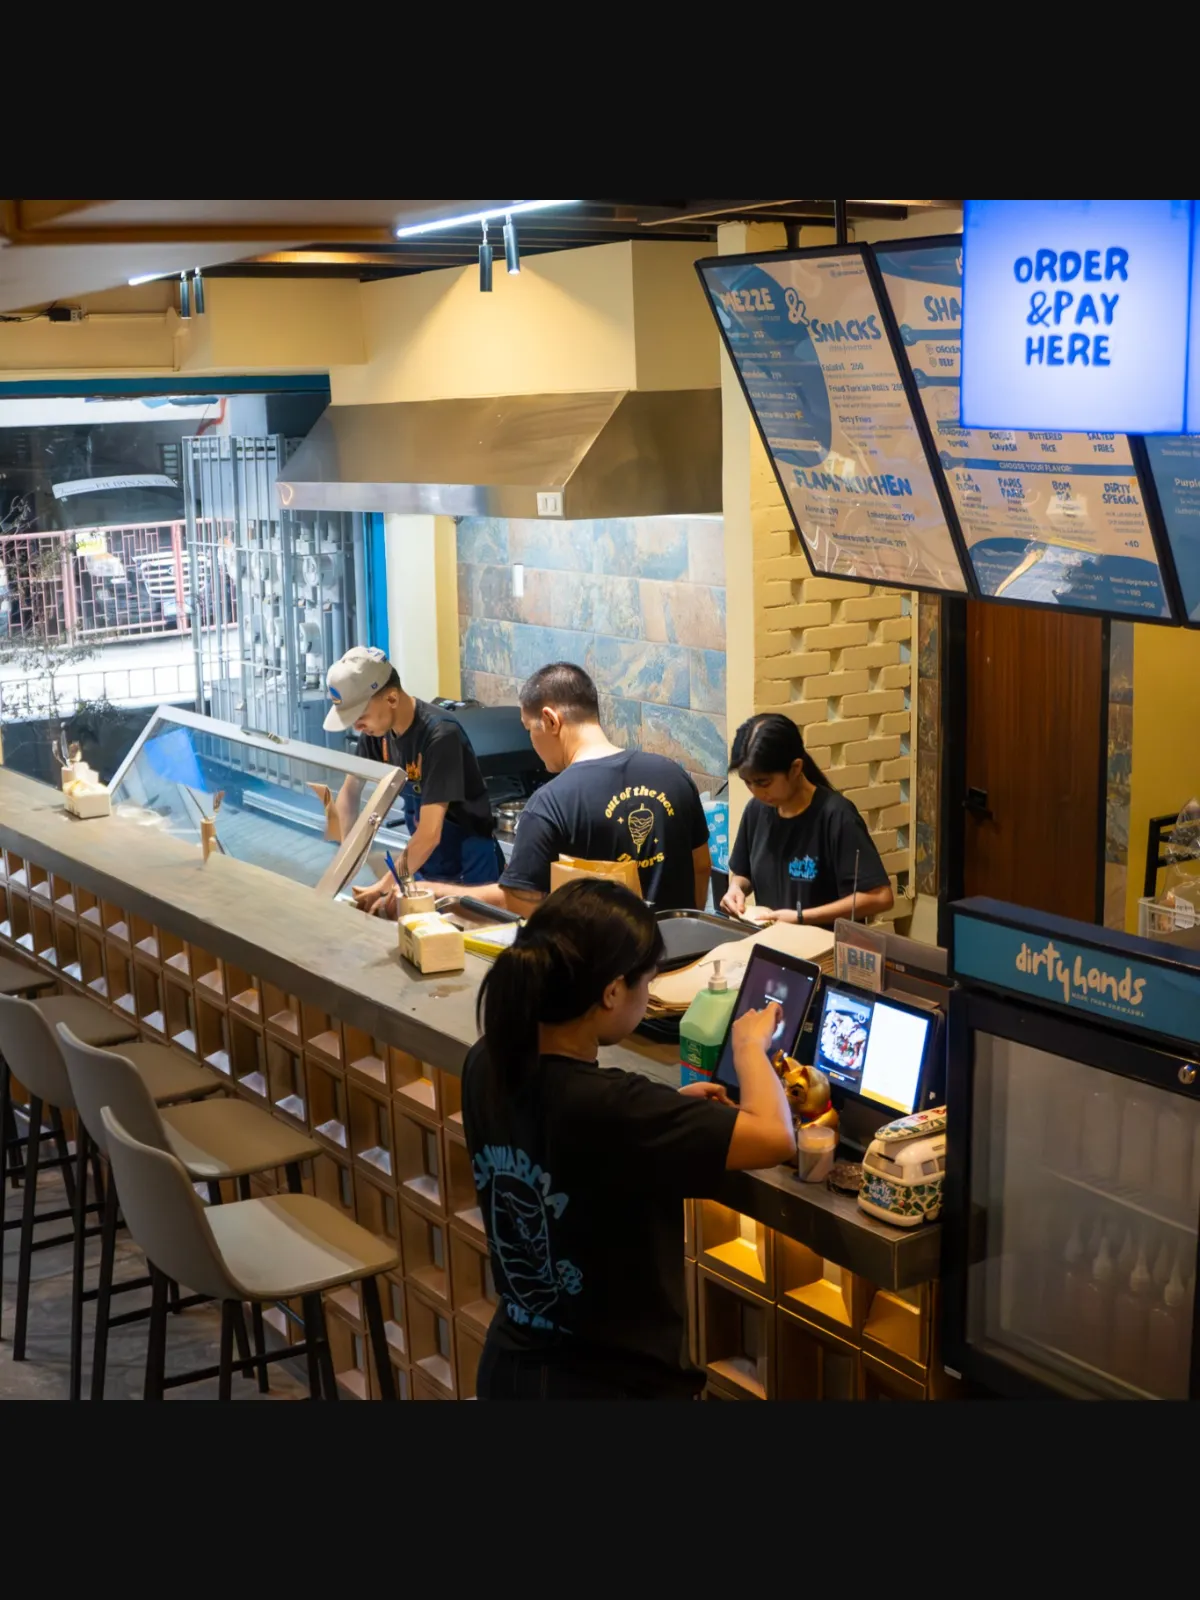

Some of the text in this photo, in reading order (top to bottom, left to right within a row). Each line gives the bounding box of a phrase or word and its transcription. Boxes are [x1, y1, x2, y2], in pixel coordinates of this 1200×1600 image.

[1013, 246, 1129, 283] ORDER
[721, 287, 776, 312] MEZZE
[810, 314, 882, 342] SNACKS
[1025, 332, 1111, 367] HERE
[604, 785, 675, 819] out of the box
[847, 947, 876, 973] BIR
[1015, 941, 1147, 1006] dirty hands
